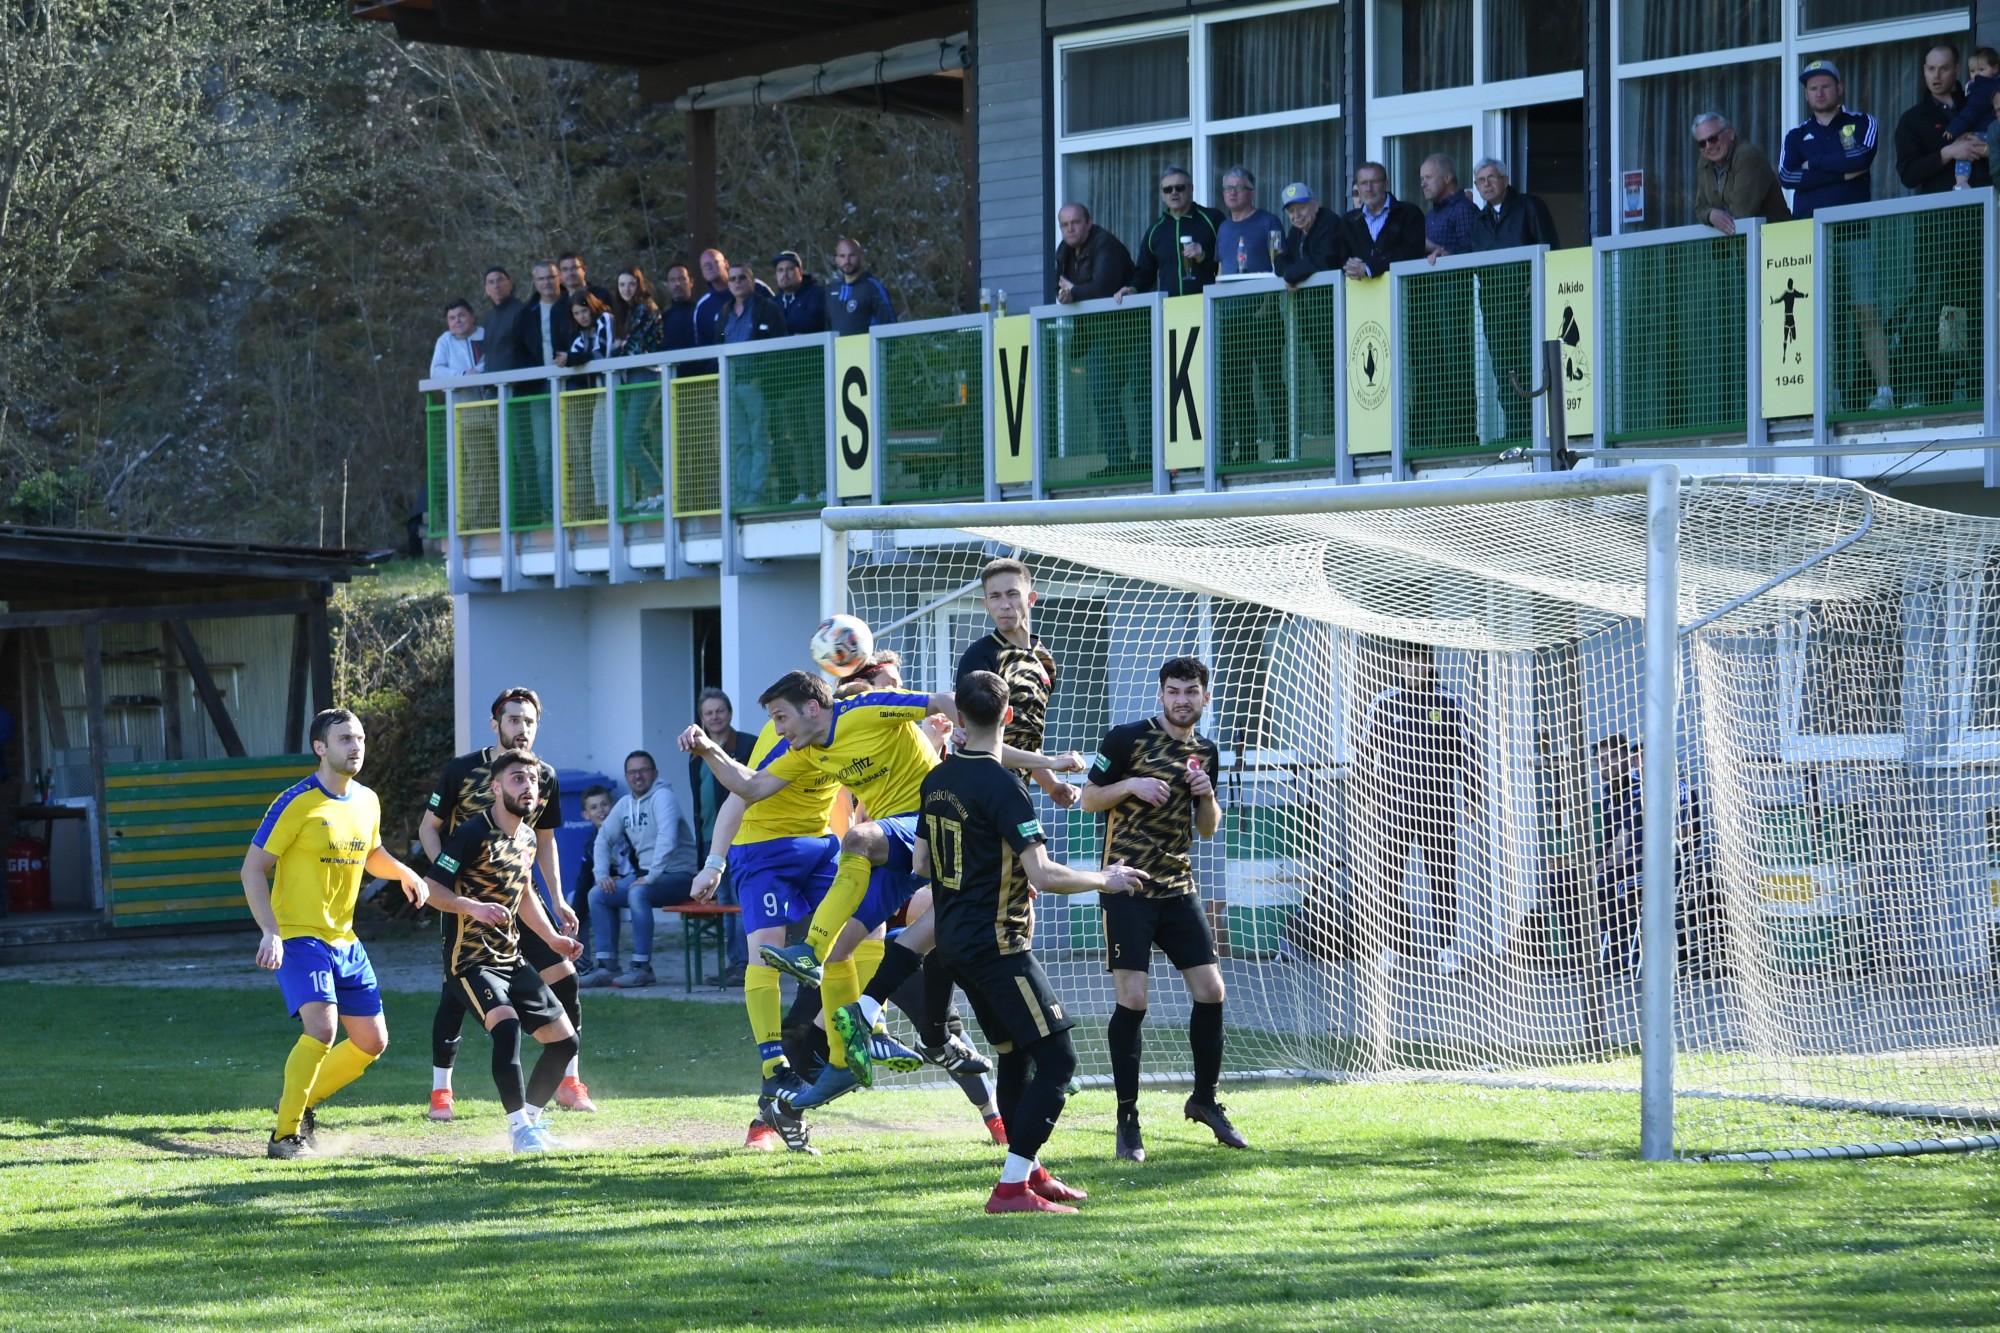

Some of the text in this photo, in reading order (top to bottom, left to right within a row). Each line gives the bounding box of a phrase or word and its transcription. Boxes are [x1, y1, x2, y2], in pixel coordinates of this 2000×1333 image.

[1766, 254, 1812, 269] Fußball
[1558, 281, 1584, 295] Aikido
[1775, 374, 1804, 387] 1946
[841, 326, 1202, 471] S V K
[1566, 397, 1582, 410] 997
[925, 813, 963, 891] 10
[763, 892, 778, 917] 9
[810, 925, 829, 937] JAKO
[1114, 943, 1121, 959] 5
[309, 970, 333, 993] 10
[484, 988, 494, 1000] 3
[1050, 1003, 1063, 1020] 10
